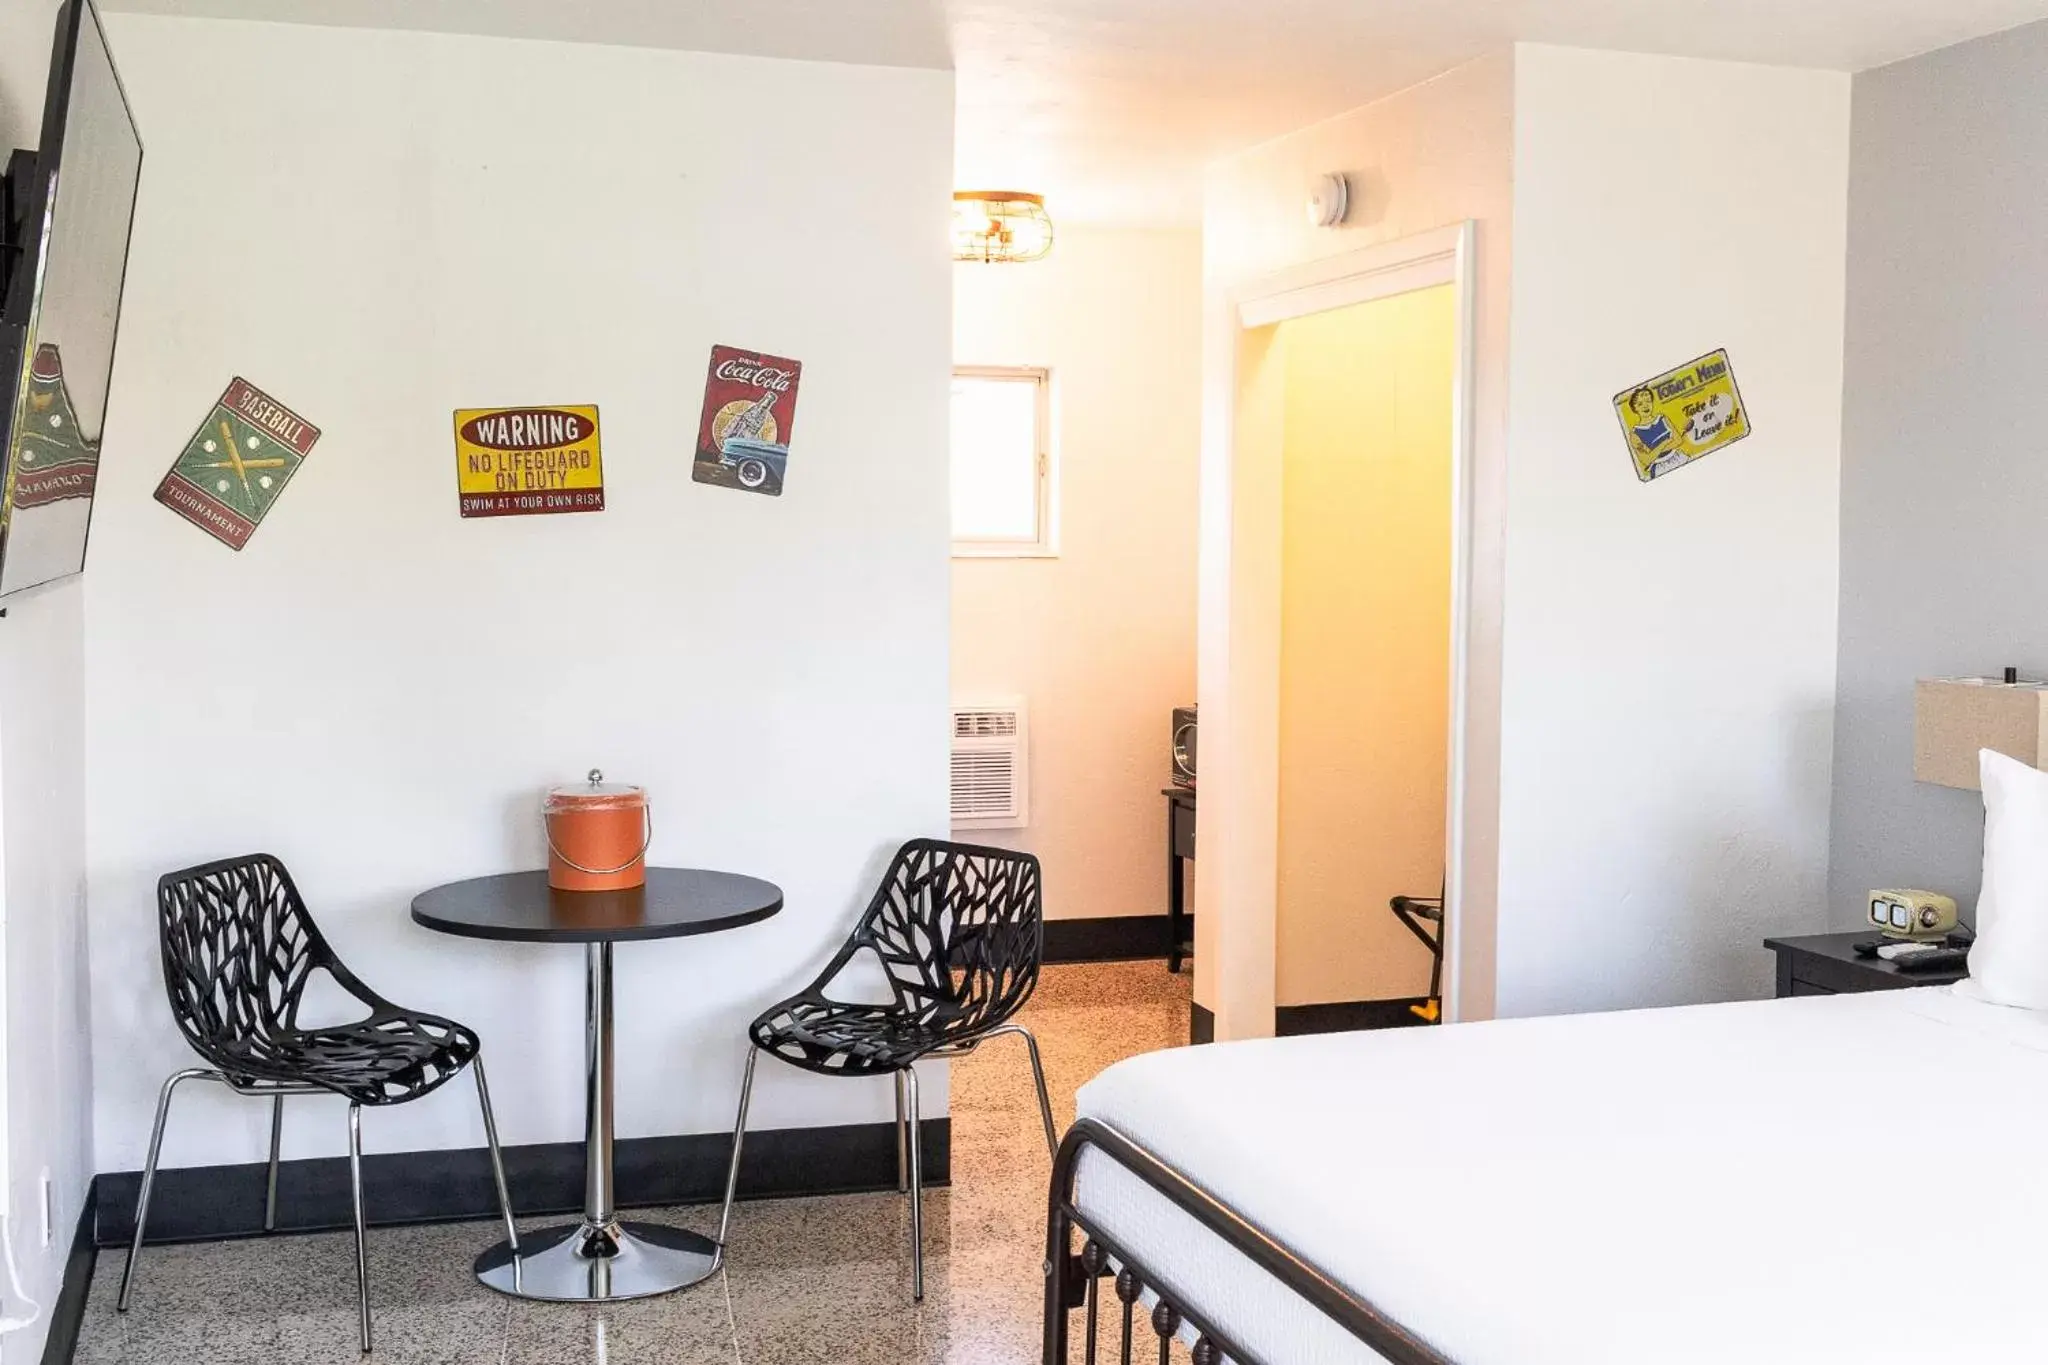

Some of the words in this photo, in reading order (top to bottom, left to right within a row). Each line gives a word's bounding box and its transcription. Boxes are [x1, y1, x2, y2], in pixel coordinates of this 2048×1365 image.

[238, 390, 304, 444] BASEBALL
[1682, 401, 1706, 417] Take
[1709, 394, 1720, 407] it
[1703, 411, 1715, 422] or
[477, 414, 579, 446] WARNING
[1694, 422, 1722, 441] Leave
[469, 455, 491, 473] NO
[499, 450, 590, 472] LIFEGUARD
[495, 472, 518, 490] ON
[525, 470, 567, 489] DUTY
[168, 485, 244, 537] TOURNAMENT
[463, 498, 494, 511] SWIM
[498, 497, 510, 509] AT
[514, 496, 543, 509] YOUR
[547, 495, 572, 507] OWN
[576, 493, 602, 505] RISK
